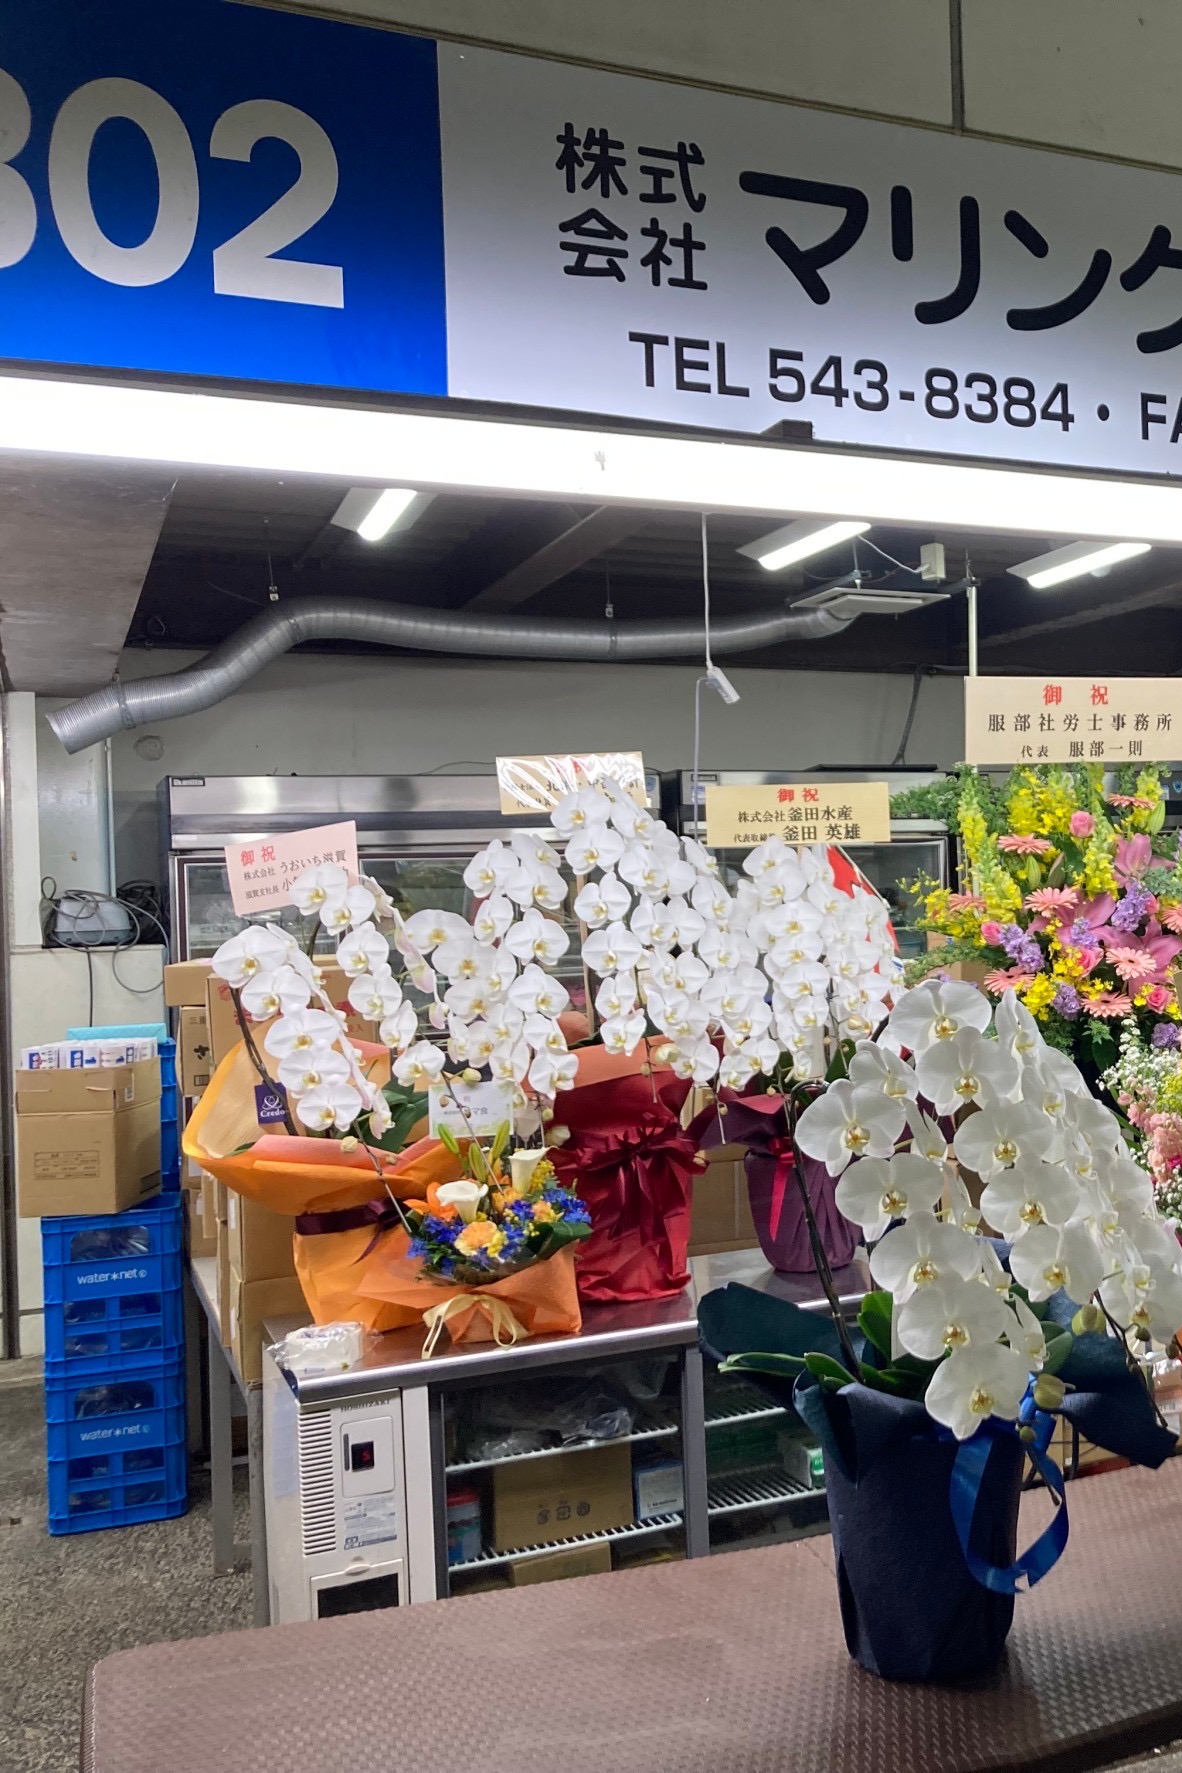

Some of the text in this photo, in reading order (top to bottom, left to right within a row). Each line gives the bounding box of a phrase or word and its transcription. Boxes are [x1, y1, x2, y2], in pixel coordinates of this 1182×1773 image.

[0, 66, 344, 309] 02
[628, 331, 749, 398] TEL
[768, 347, 1074, 433] 543-8384
[988, 712, 1172, 732] 服部社労士事務所
[1021, 740, 1143, 758] 代表 服部一則
[734, 833, 776, 843] 代表取締
[260, 1108, 286, 1118] Credo
